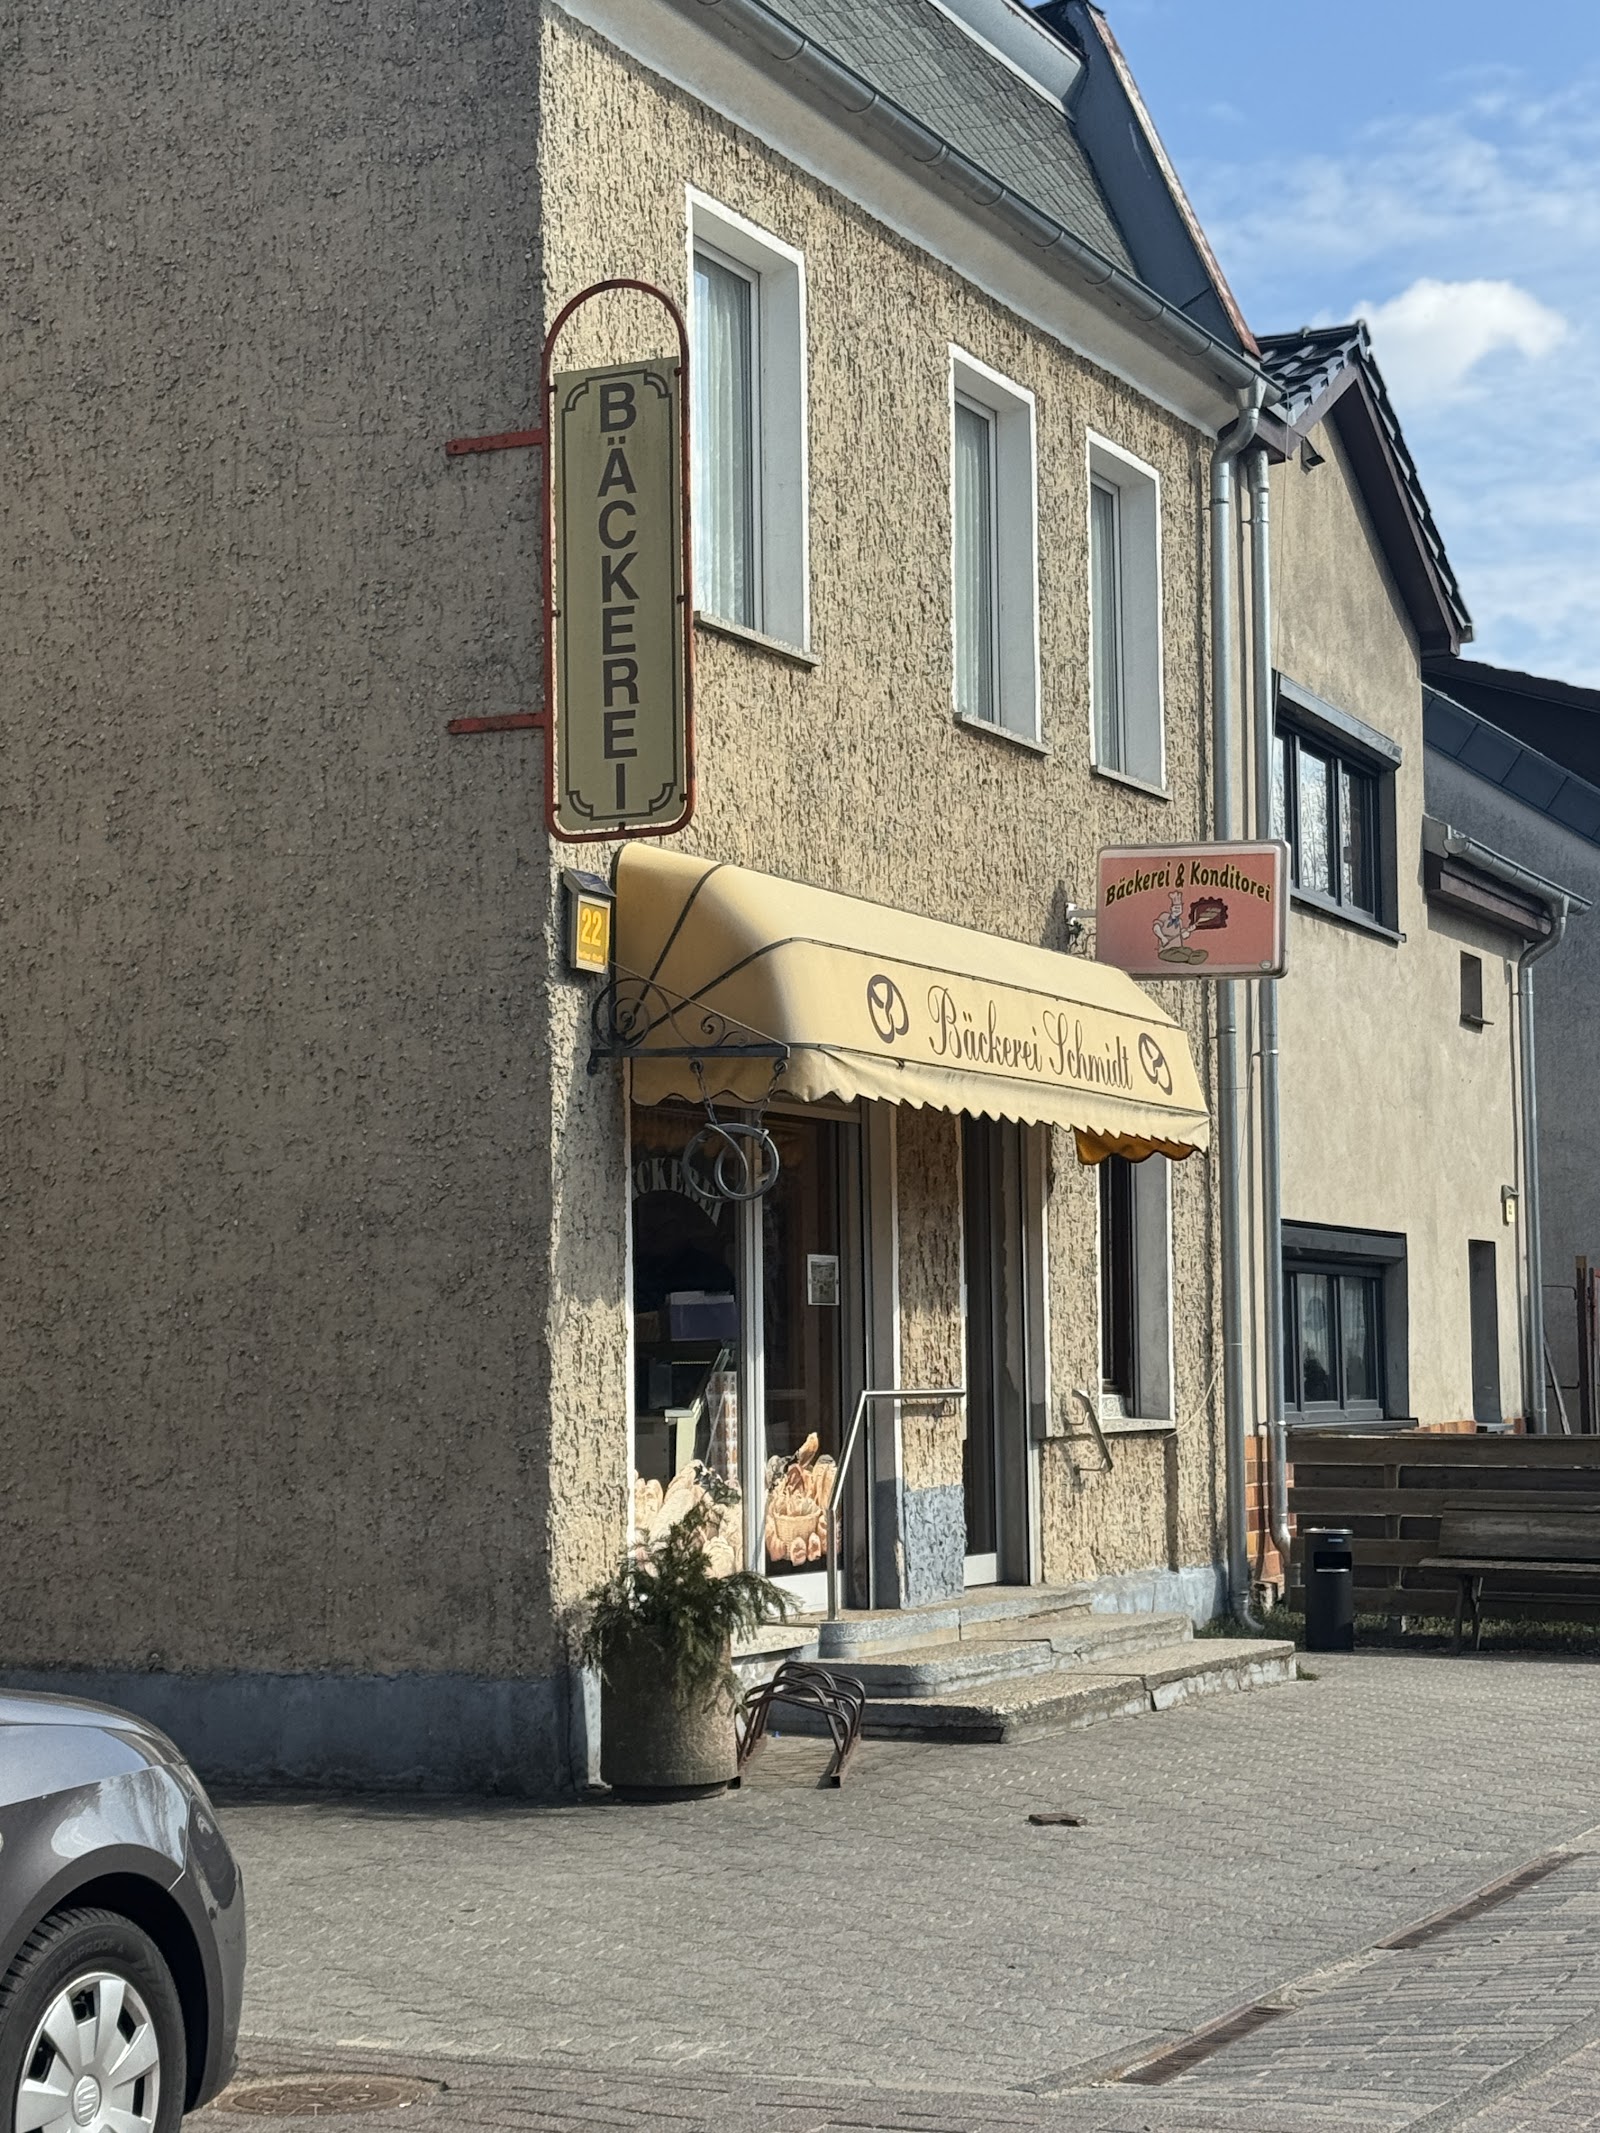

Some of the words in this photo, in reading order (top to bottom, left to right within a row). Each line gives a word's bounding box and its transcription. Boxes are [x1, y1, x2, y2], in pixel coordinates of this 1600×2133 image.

[597, 380, 640, 810] BÄCKEREI
[1105, 861, 1171, 907] Bäckerei
[1174, 862, 1185, 889] &
[1189, 859, 1273, 903] Konditorei
[580, 907, 603, 947] 22
[927, 984, 1043, 1073] Bäckerei
[1042, 1009, 1134, 1090] Schmidt
